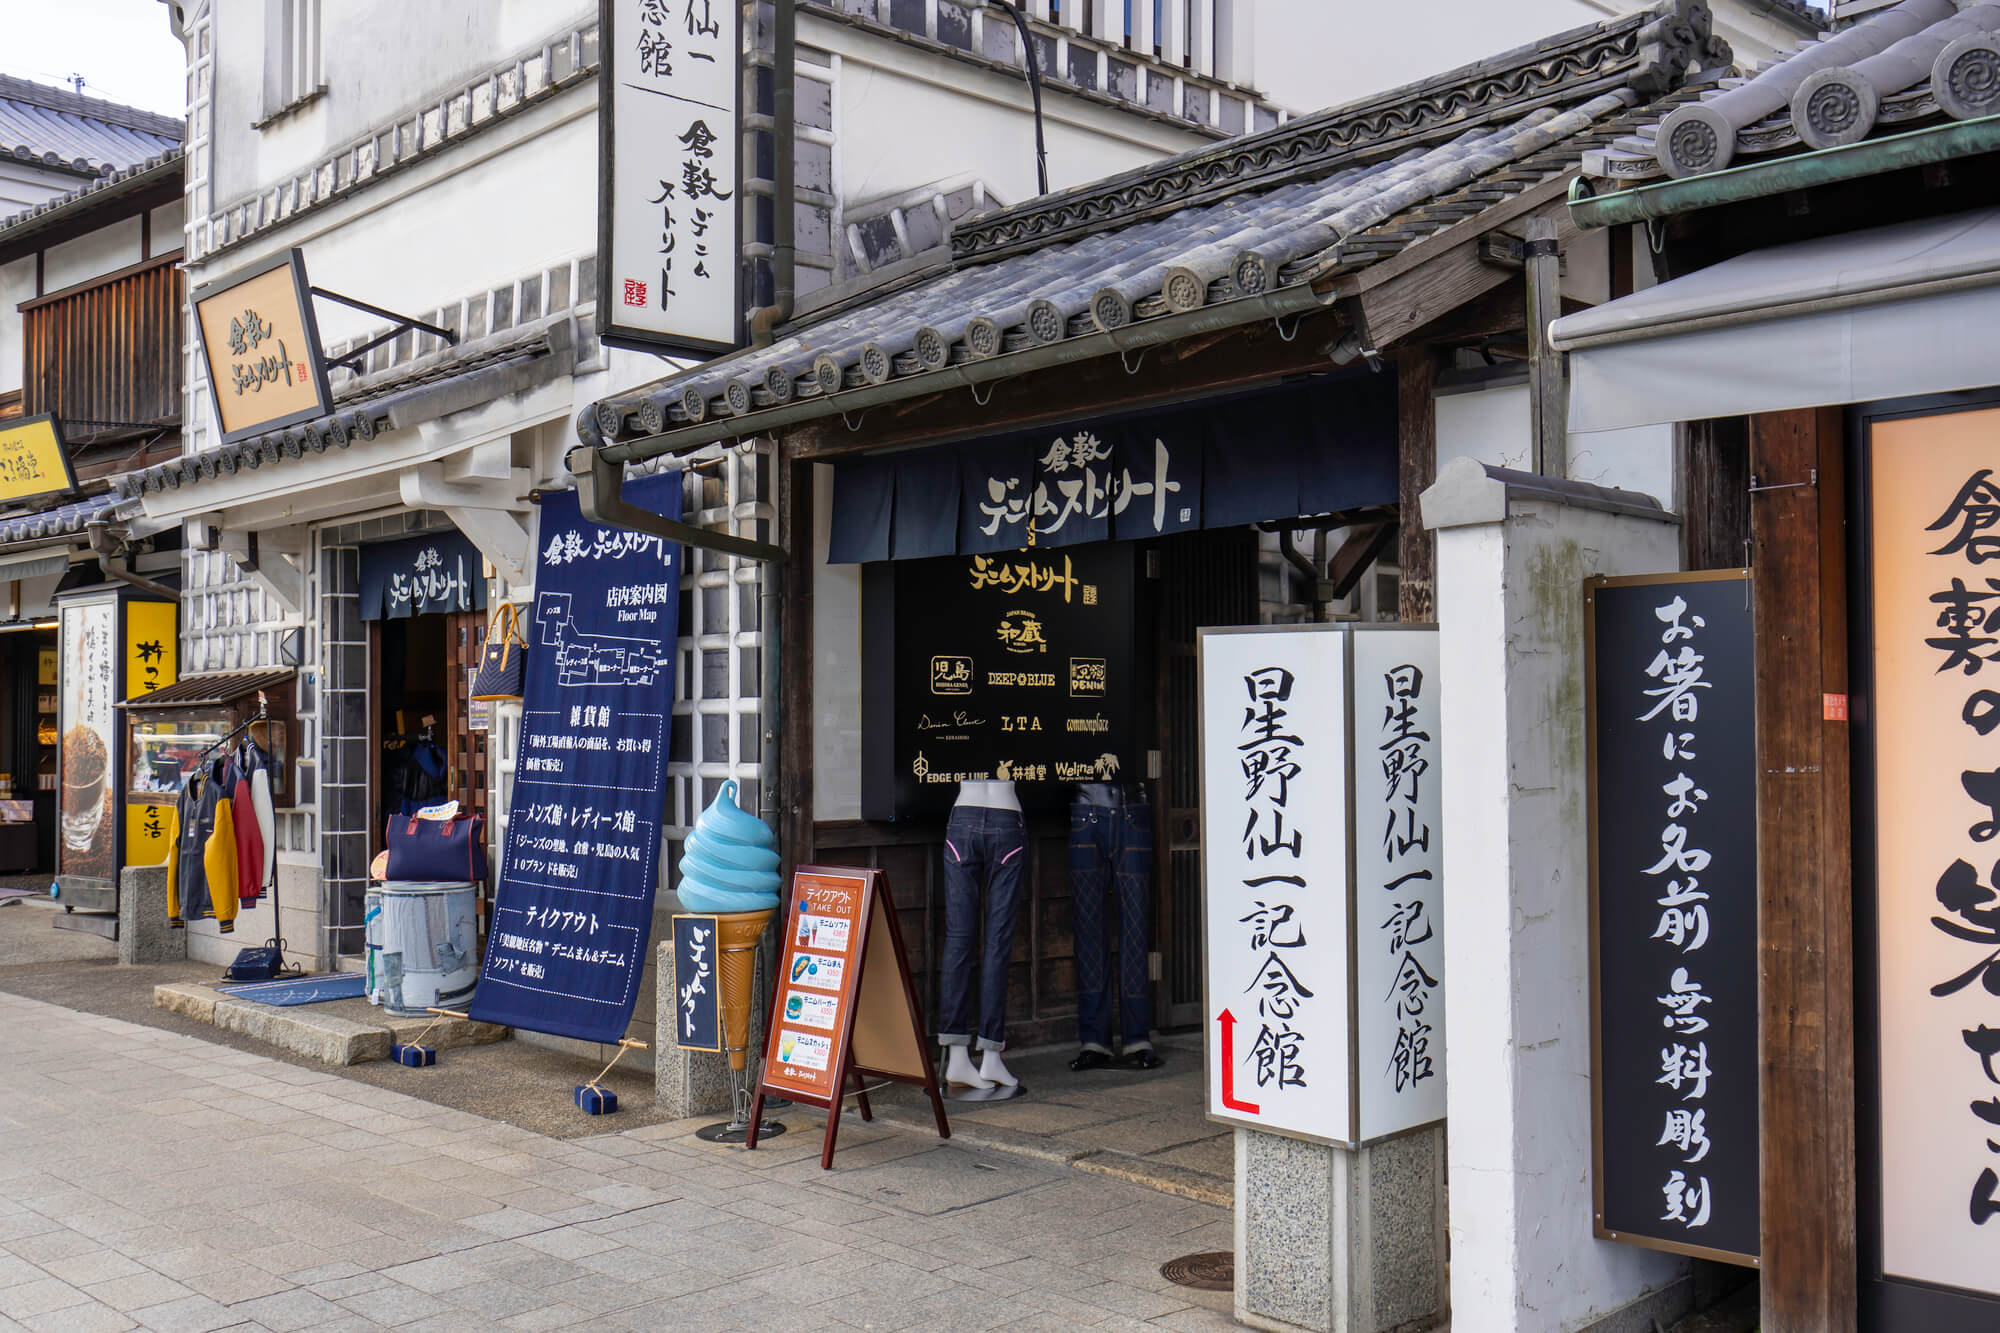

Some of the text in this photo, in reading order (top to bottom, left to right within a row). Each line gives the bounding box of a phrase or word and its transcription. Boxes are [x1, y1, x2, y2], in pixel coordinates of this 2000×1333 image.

[676, 119, 733, 279] 倉敷デニム
[647, 180, 676, 312] ストリート
[227, 309, 272, 356] 倉敷
[232, 339, 293, 396] デニムストリート
[1038, 430, 1113, 473] 倉敷
[979, 438, 1181, 536] デニムストリート
[414, 547, 443, 572] 倉敷
[543, 529, 591, 565] 倉敷
[390, 554, 468, 610] デニムストリート
[969, 554, 1079, 604] デニムストリート
[607, 583, 668, 608] 店内案内図
[617, 608, 657, 623] Floor Map
[997, 619, 1047, 644] 和蔵
[934, 661, 970, 681] 児島
[988, 672, 1056, 687] DEEP BLUE
[1072, 680, 1105, 690] DENIM
[570, 705, 611, 728] 雑貨館
[1066, 712, 1109, 736] commonplace
[927, 773, 952, 783] EDGE
[954, 773, 966, 782] OF
[1012, 764, 1047, 781] 林檎堂
[1237, 666, 1314, 1091] 星野仙一記念館
[1379, 663, 1439, 1093] 星野仙一記念館
[807, 888, 852, 904] テイクアウト
[813, 902, 852, 914] TAKE OUT
[526, 906, 599, 935] テイクアウト
[690, 926, 711, 995] デニム
[681, 983, 696, 1039] ソフト
